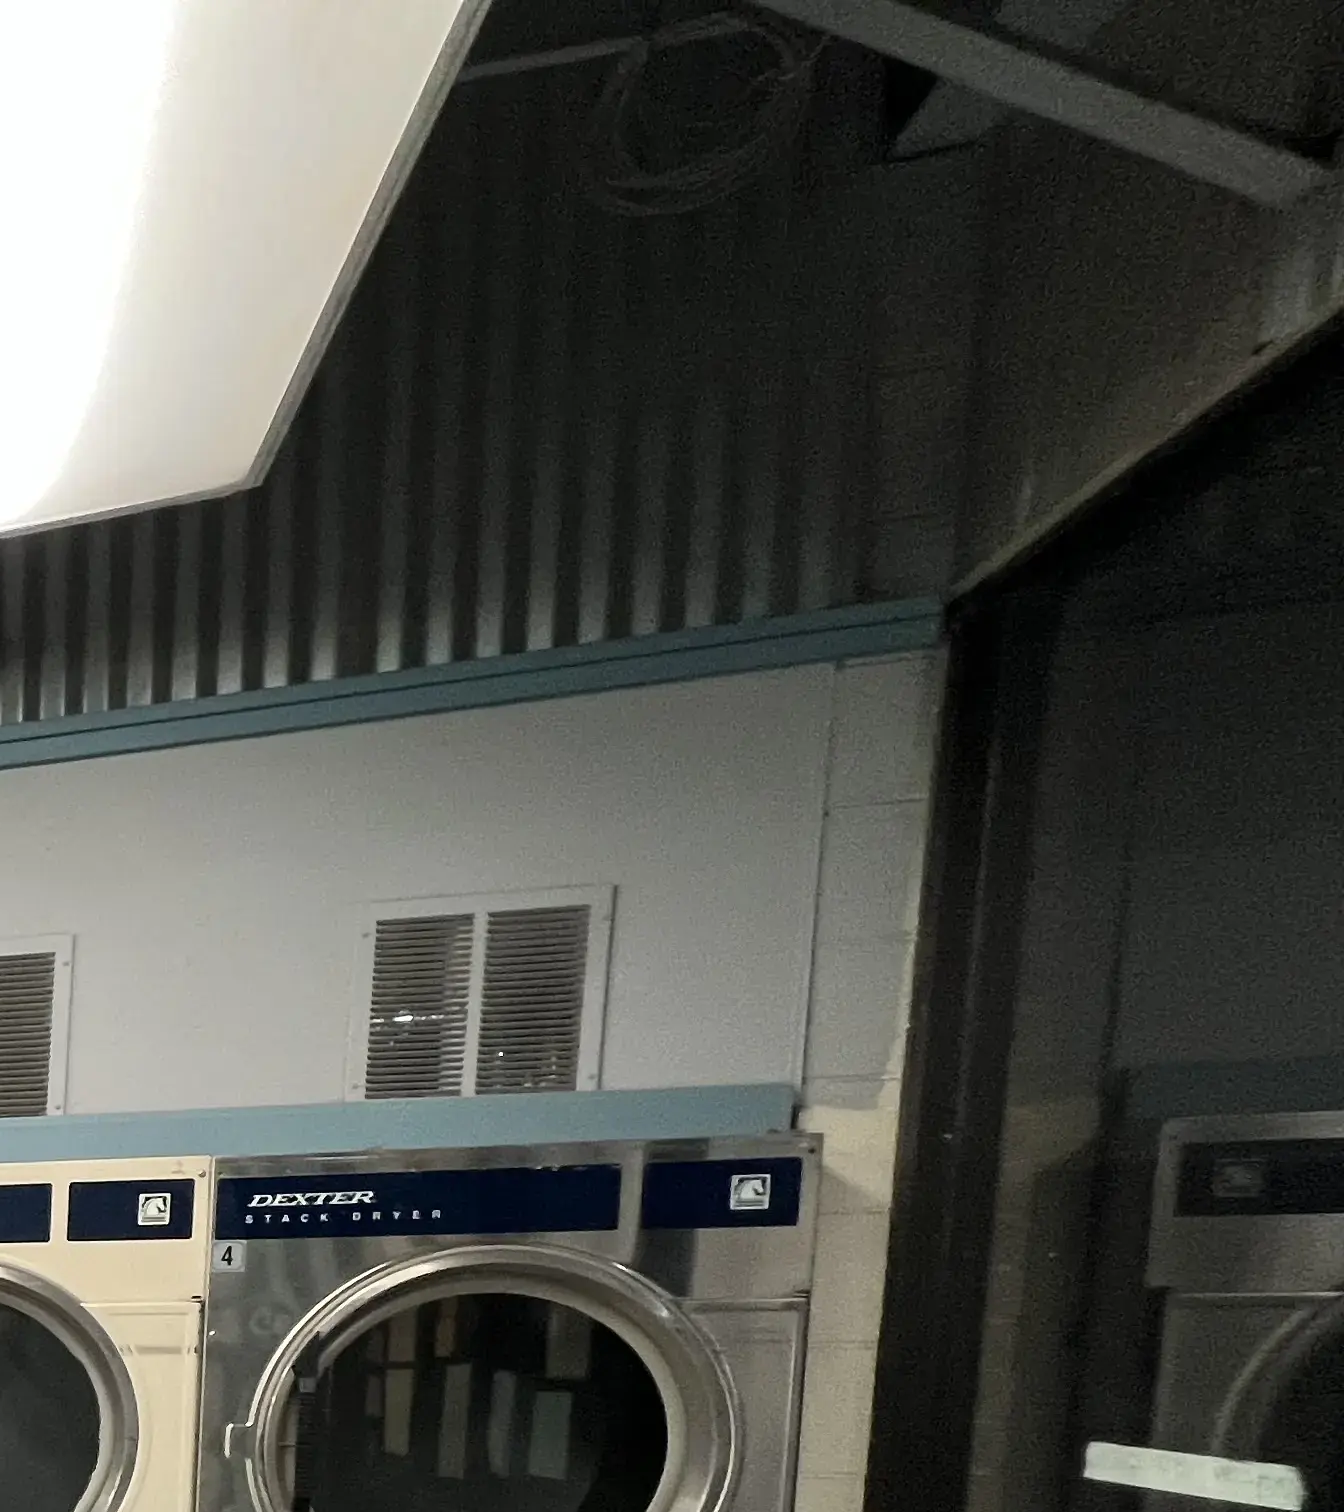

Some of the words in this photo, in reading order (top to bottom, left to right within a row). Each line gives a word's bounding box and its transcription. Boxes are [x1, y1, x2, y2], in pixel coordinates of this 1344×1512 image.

[247, 1190, 375, 1208] DEXTER
[244, 1213, 329, 1224] STACK
[352, 1210, 441, 1222] DRYER
[221, 1245, 234, 1266] 4
